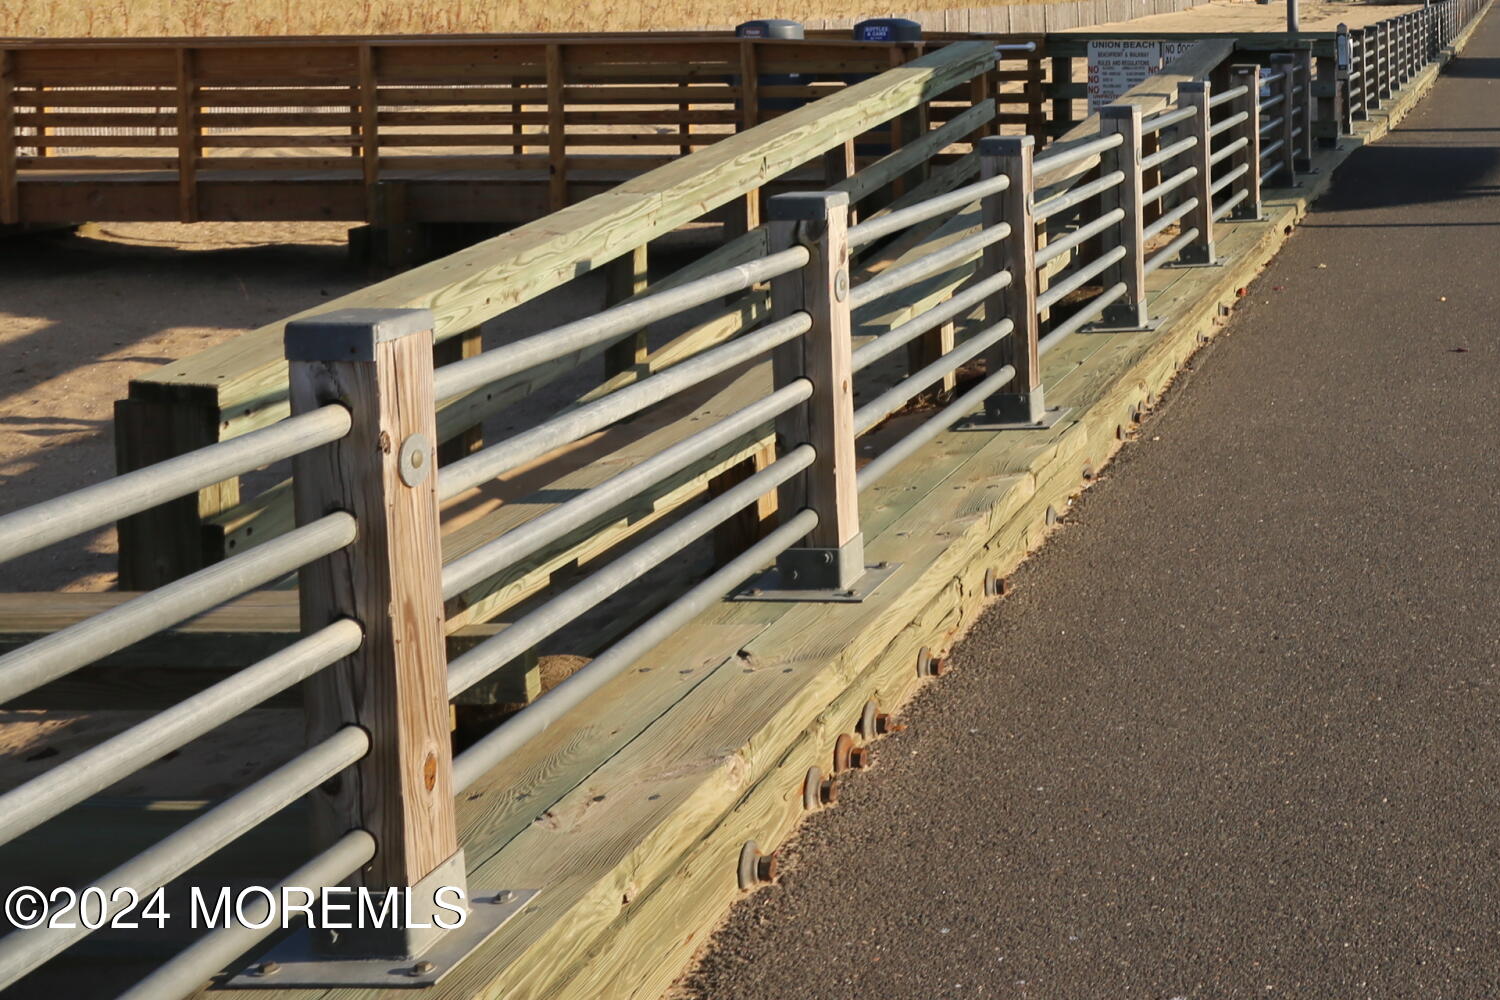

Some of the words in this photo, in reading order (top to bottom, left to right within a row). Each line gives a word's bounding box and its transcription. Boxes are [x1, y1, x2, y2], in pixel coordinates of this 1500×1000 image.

[1091, 41, 1120, 49] UNION
[1123, 41, 1155, 49] BEACH
[1166, 44, 1175, 54] NO
[1088, 66, 1099, 74] NO
[1088, 75, 1099, 83] NO
[1088, 85, 1100, 94] NO
